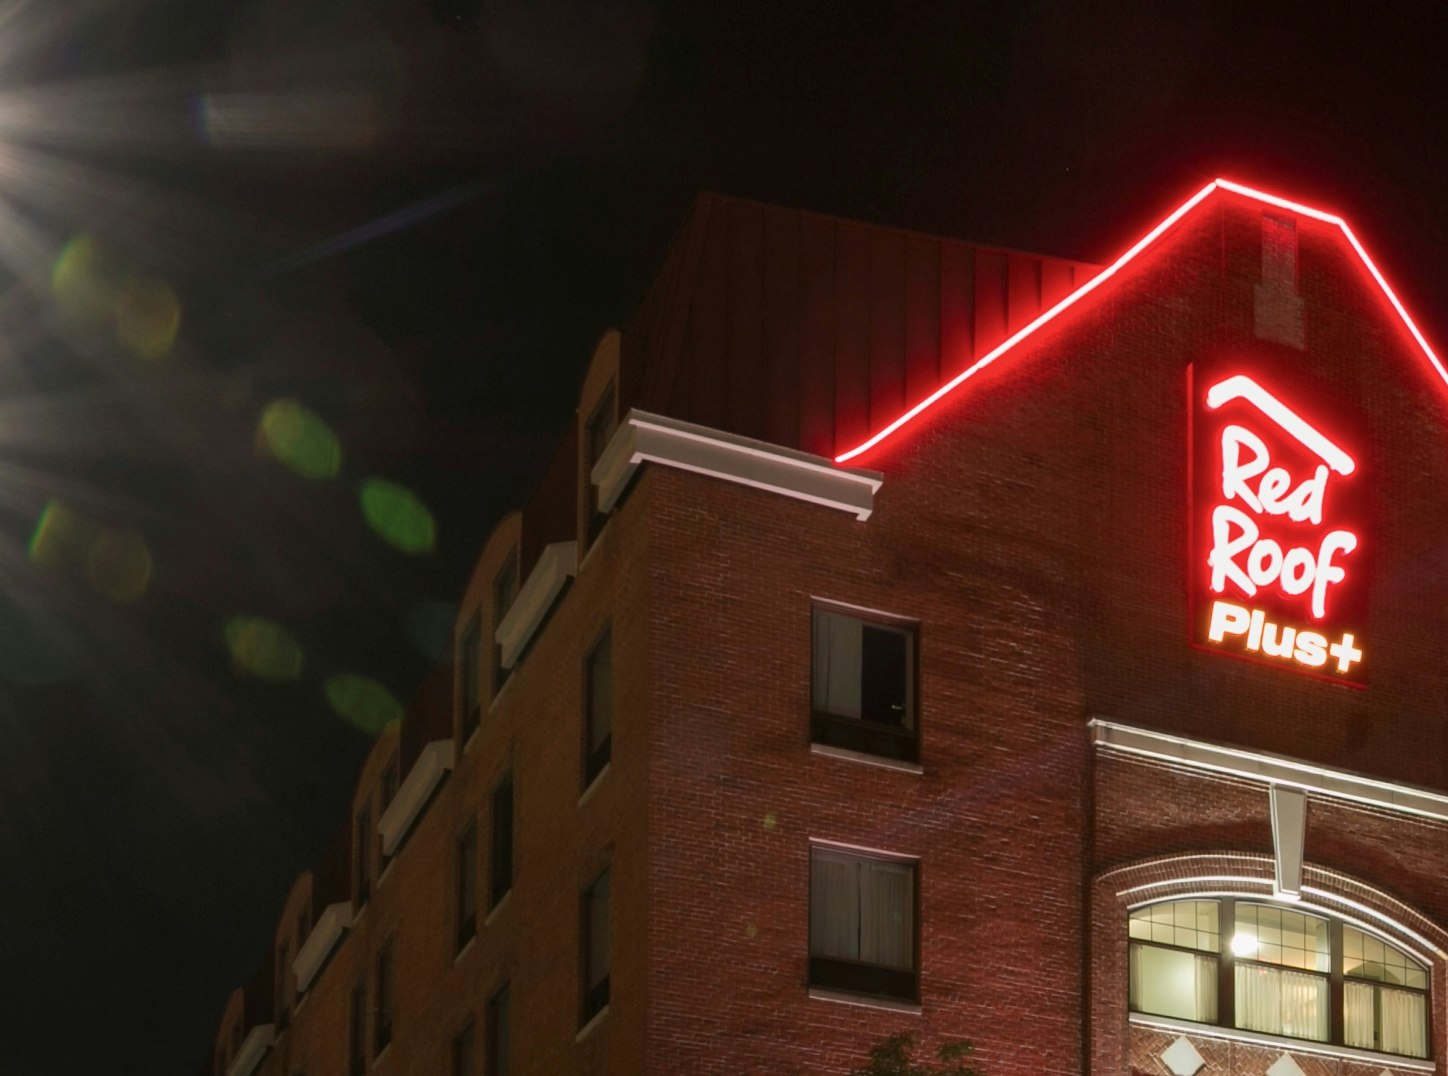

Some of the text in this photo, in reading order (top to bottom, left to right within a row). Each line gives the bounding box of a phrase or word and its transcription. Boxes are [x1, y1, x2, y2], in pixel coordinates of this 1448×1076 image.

[1222, 425, 1329, 525] Red
[1208, 505, 1357, 618] Roof
[1208, 601, 1362, 672] Plus+
